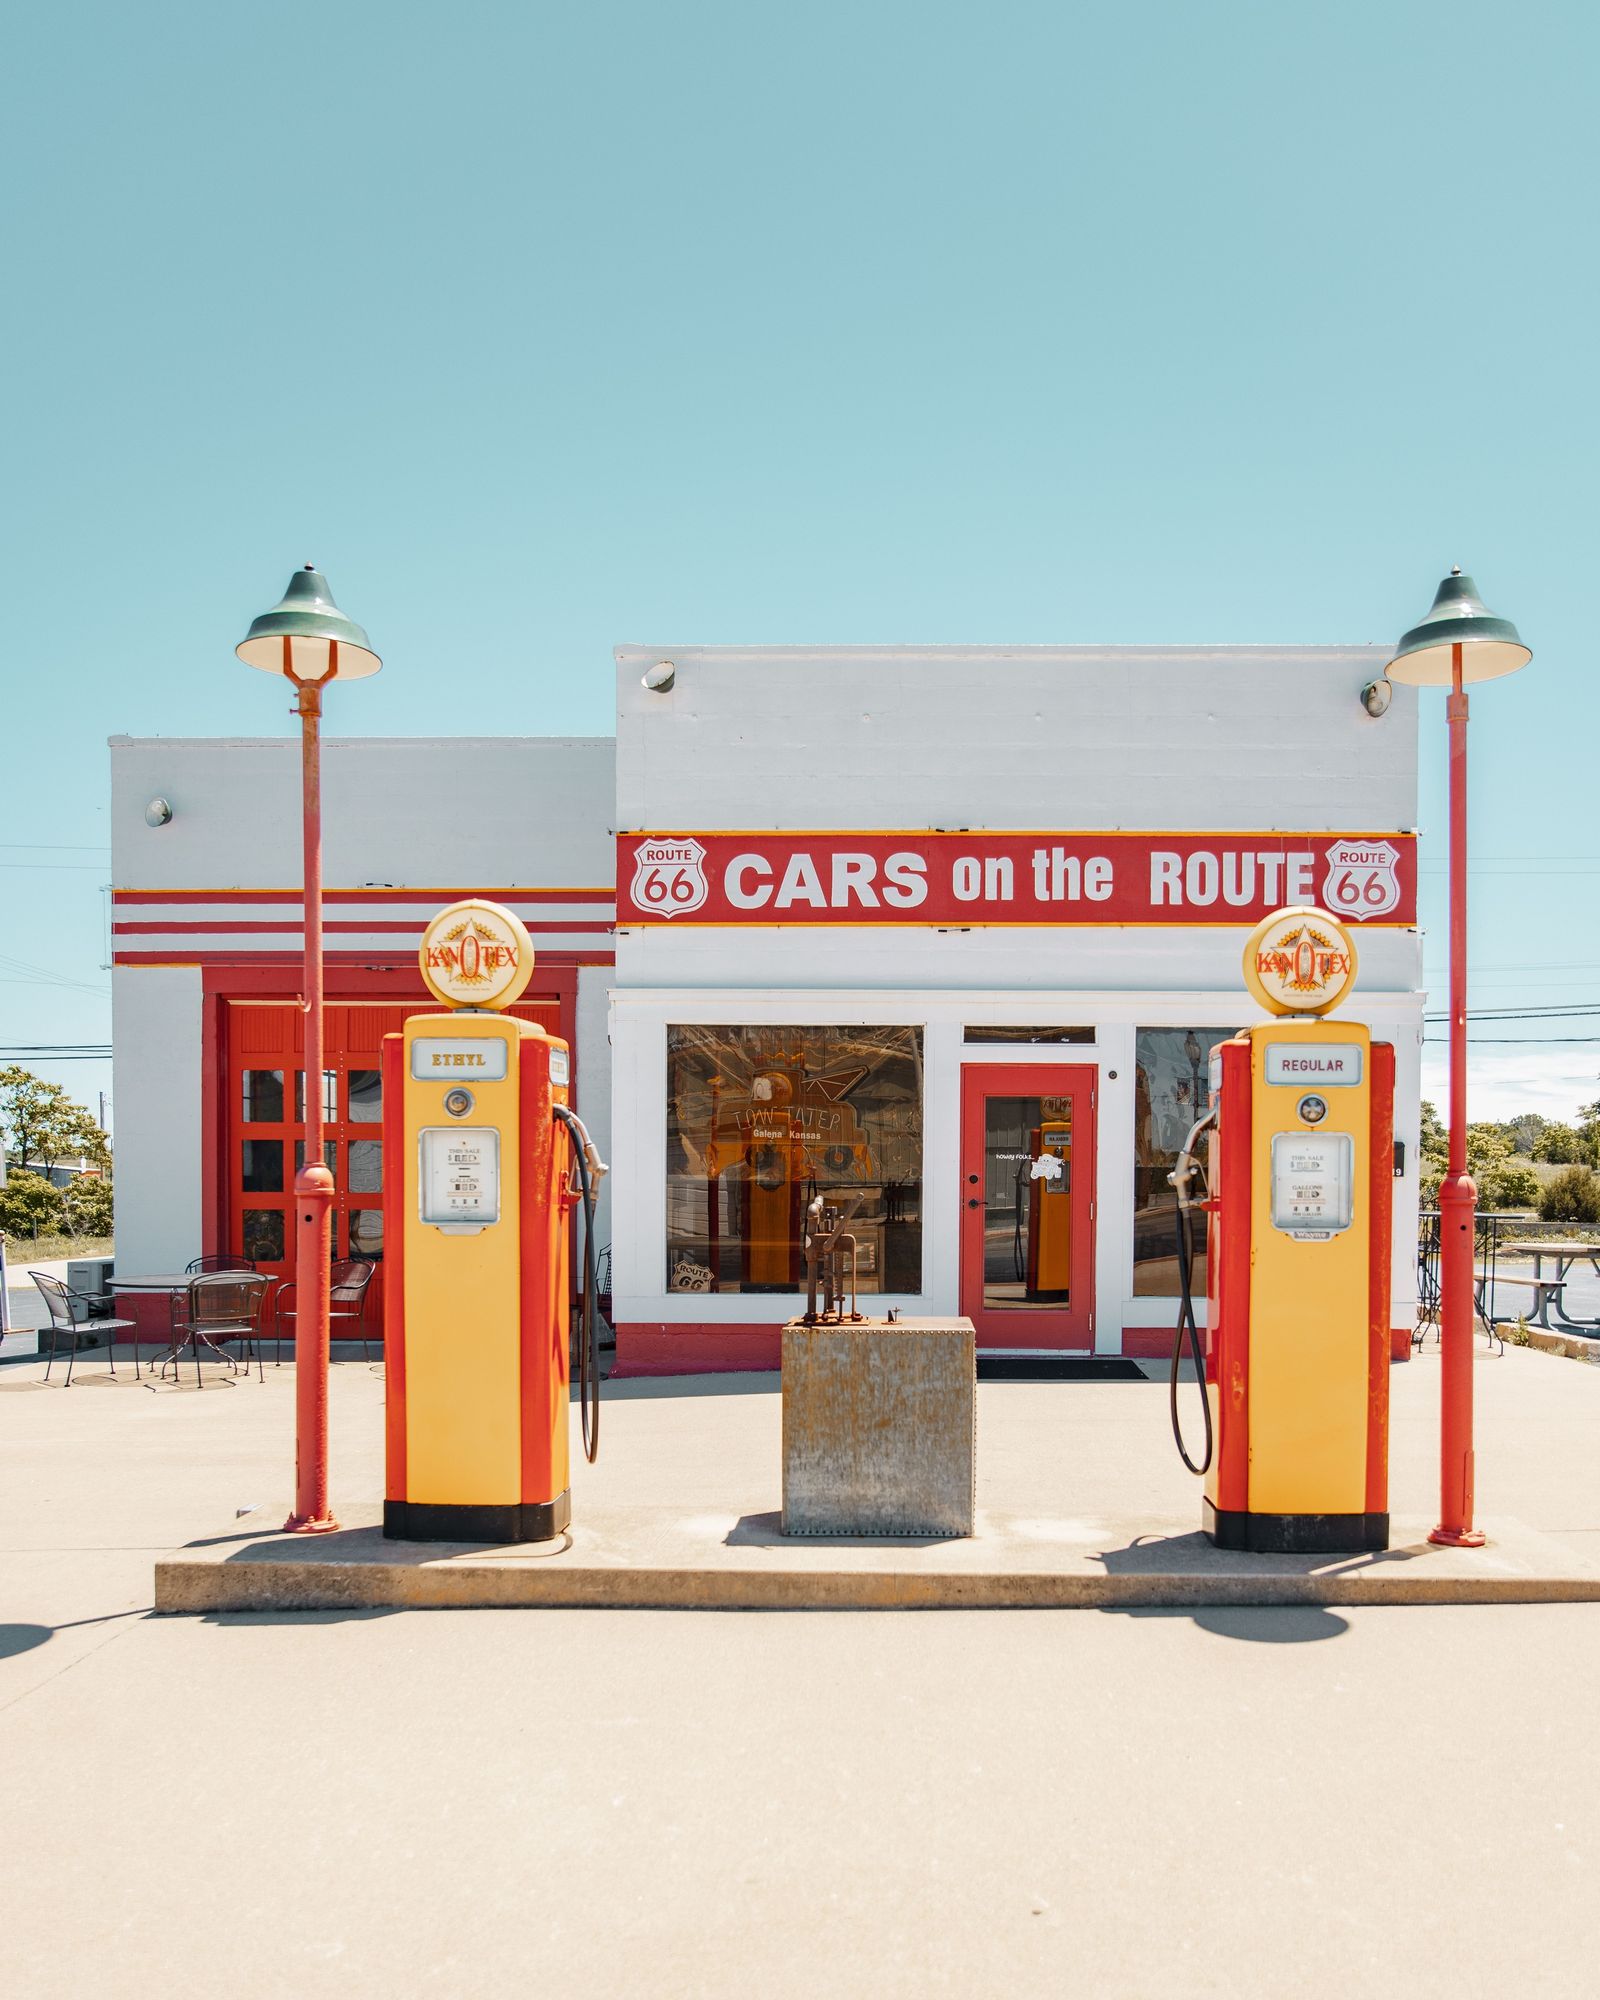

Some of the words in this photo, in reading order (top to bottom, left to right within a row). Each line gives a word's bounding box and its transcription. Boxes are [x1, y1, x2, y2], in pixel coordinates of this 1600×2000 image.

[646, 849, 692, 861] ROUTE
[1339, 851, 1386, 864] ROUTE
[723, 851, 929, 910] CARS
[952, 856, 1014, 901] on
[1031, 847, 1114, 901] the
[1150, 851, 1315, 906] ROUTE
[643, 868, 695, 903] 66
[1336, 870, 1387, 905] 66
[432, 1054, 486, 1067] ETHYL
[1282, 1059, 1344, 1072] REGULAR
[753, 1129, 782, 1139] Galena
[789, 1130, 821, 1140] Kansas
[680, 1264, 709, 1279] ROUTE
[678, 1276, 704, 1290] 66
